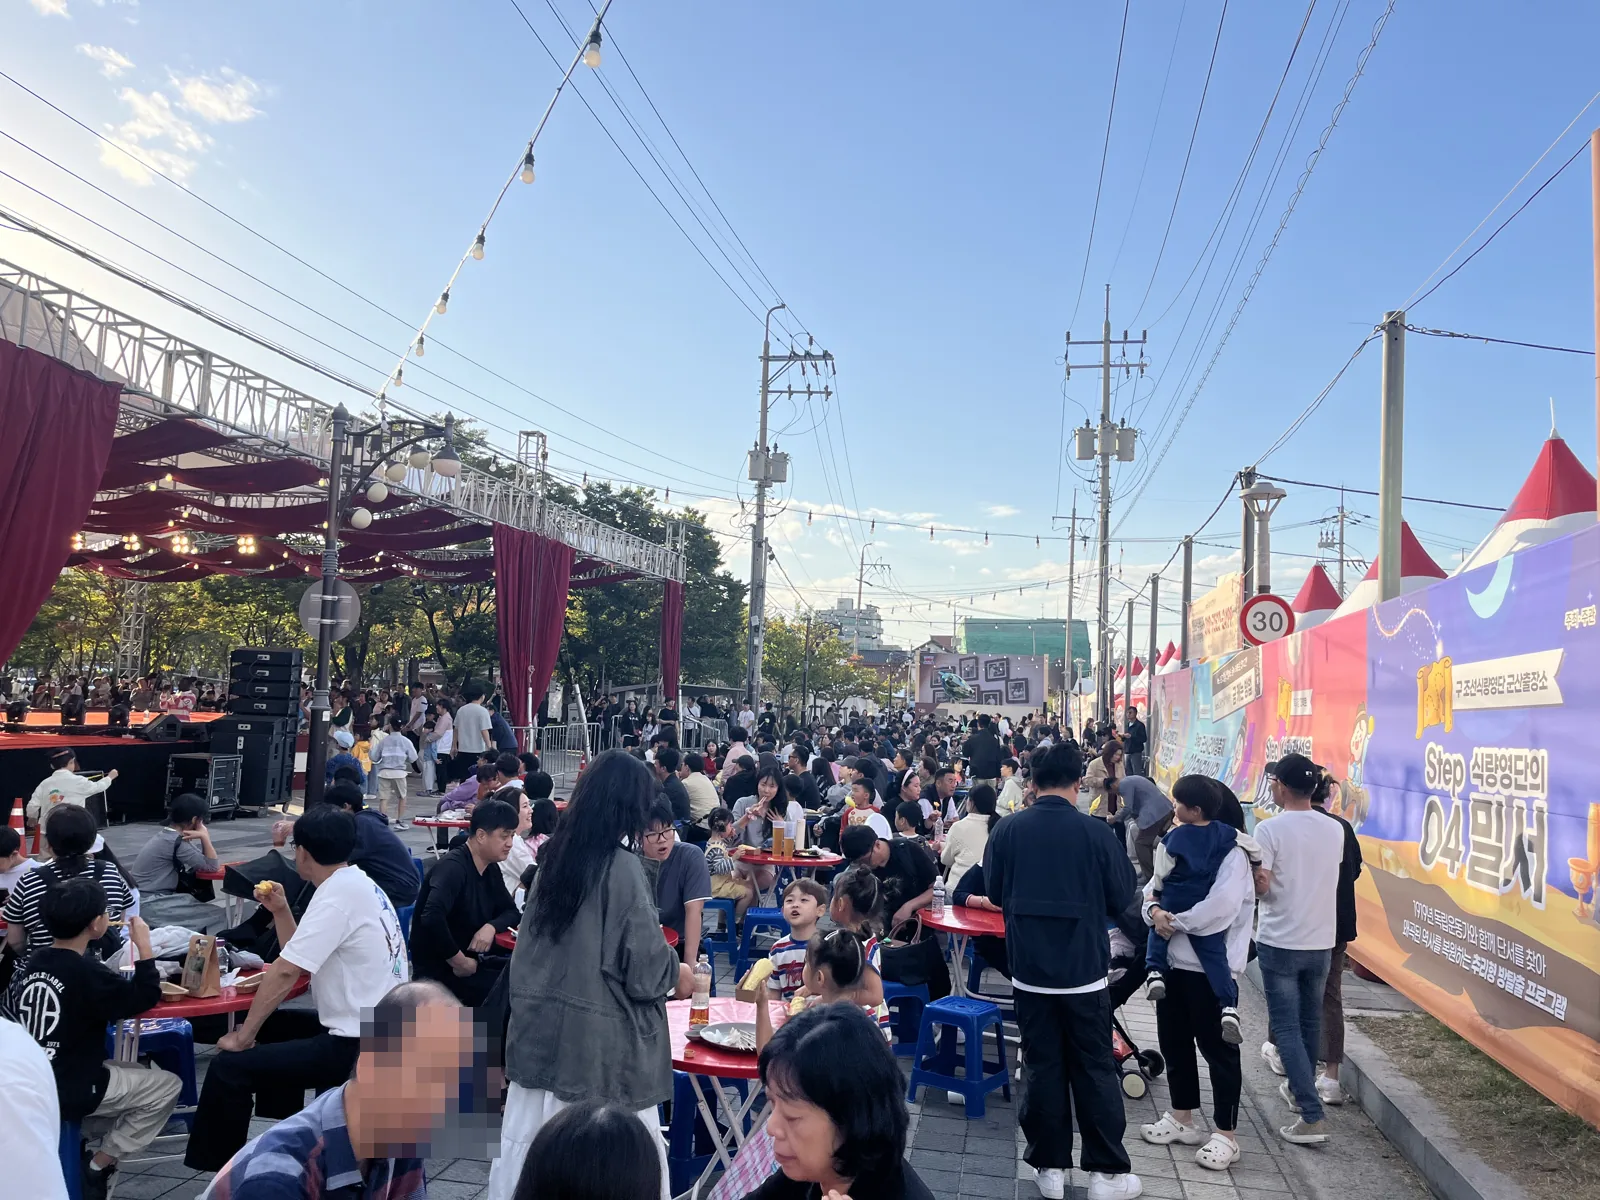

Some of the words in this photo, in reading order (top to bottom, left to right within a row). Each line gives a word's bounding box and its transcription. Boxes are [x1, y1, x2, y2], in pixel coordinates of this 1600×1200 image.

[1252, 611, 1283, 632] 30
[1455, 680, 1463, 699] 구
[1463, 675, 1505, 697] 조선식량영단
[1506, 670, 1548, 694] 군산출장소
[1426, 746, 1465, 798] Step
[1471, 751, 1545, 794] 식량영단의
[1420, 799, 1463, 875] 04
[1466, 797, 1545, 904] 밀서
[1412, 899, 1434, 926] 1919년
[1433, 910, 1479, 947] 독립운동가와
[1478, 928, 1496, 954] 함께
[1497, 936, 1525, 969] 단서를
[1525, 948, 1547, 978] 찾아
[46, 973, 65, 994] LABEL
[1402, 919, 1422, 945] 왜곡된
[1421, 928, 1442, 955] 역사를
[1441, 936, 1472, 972] 복원하는
[1471, 952, 1498, 985] 추리형
[1496, 965, 1526, 1000] 방탈출
[1524, 979, 1568, 1022] 프로그램
